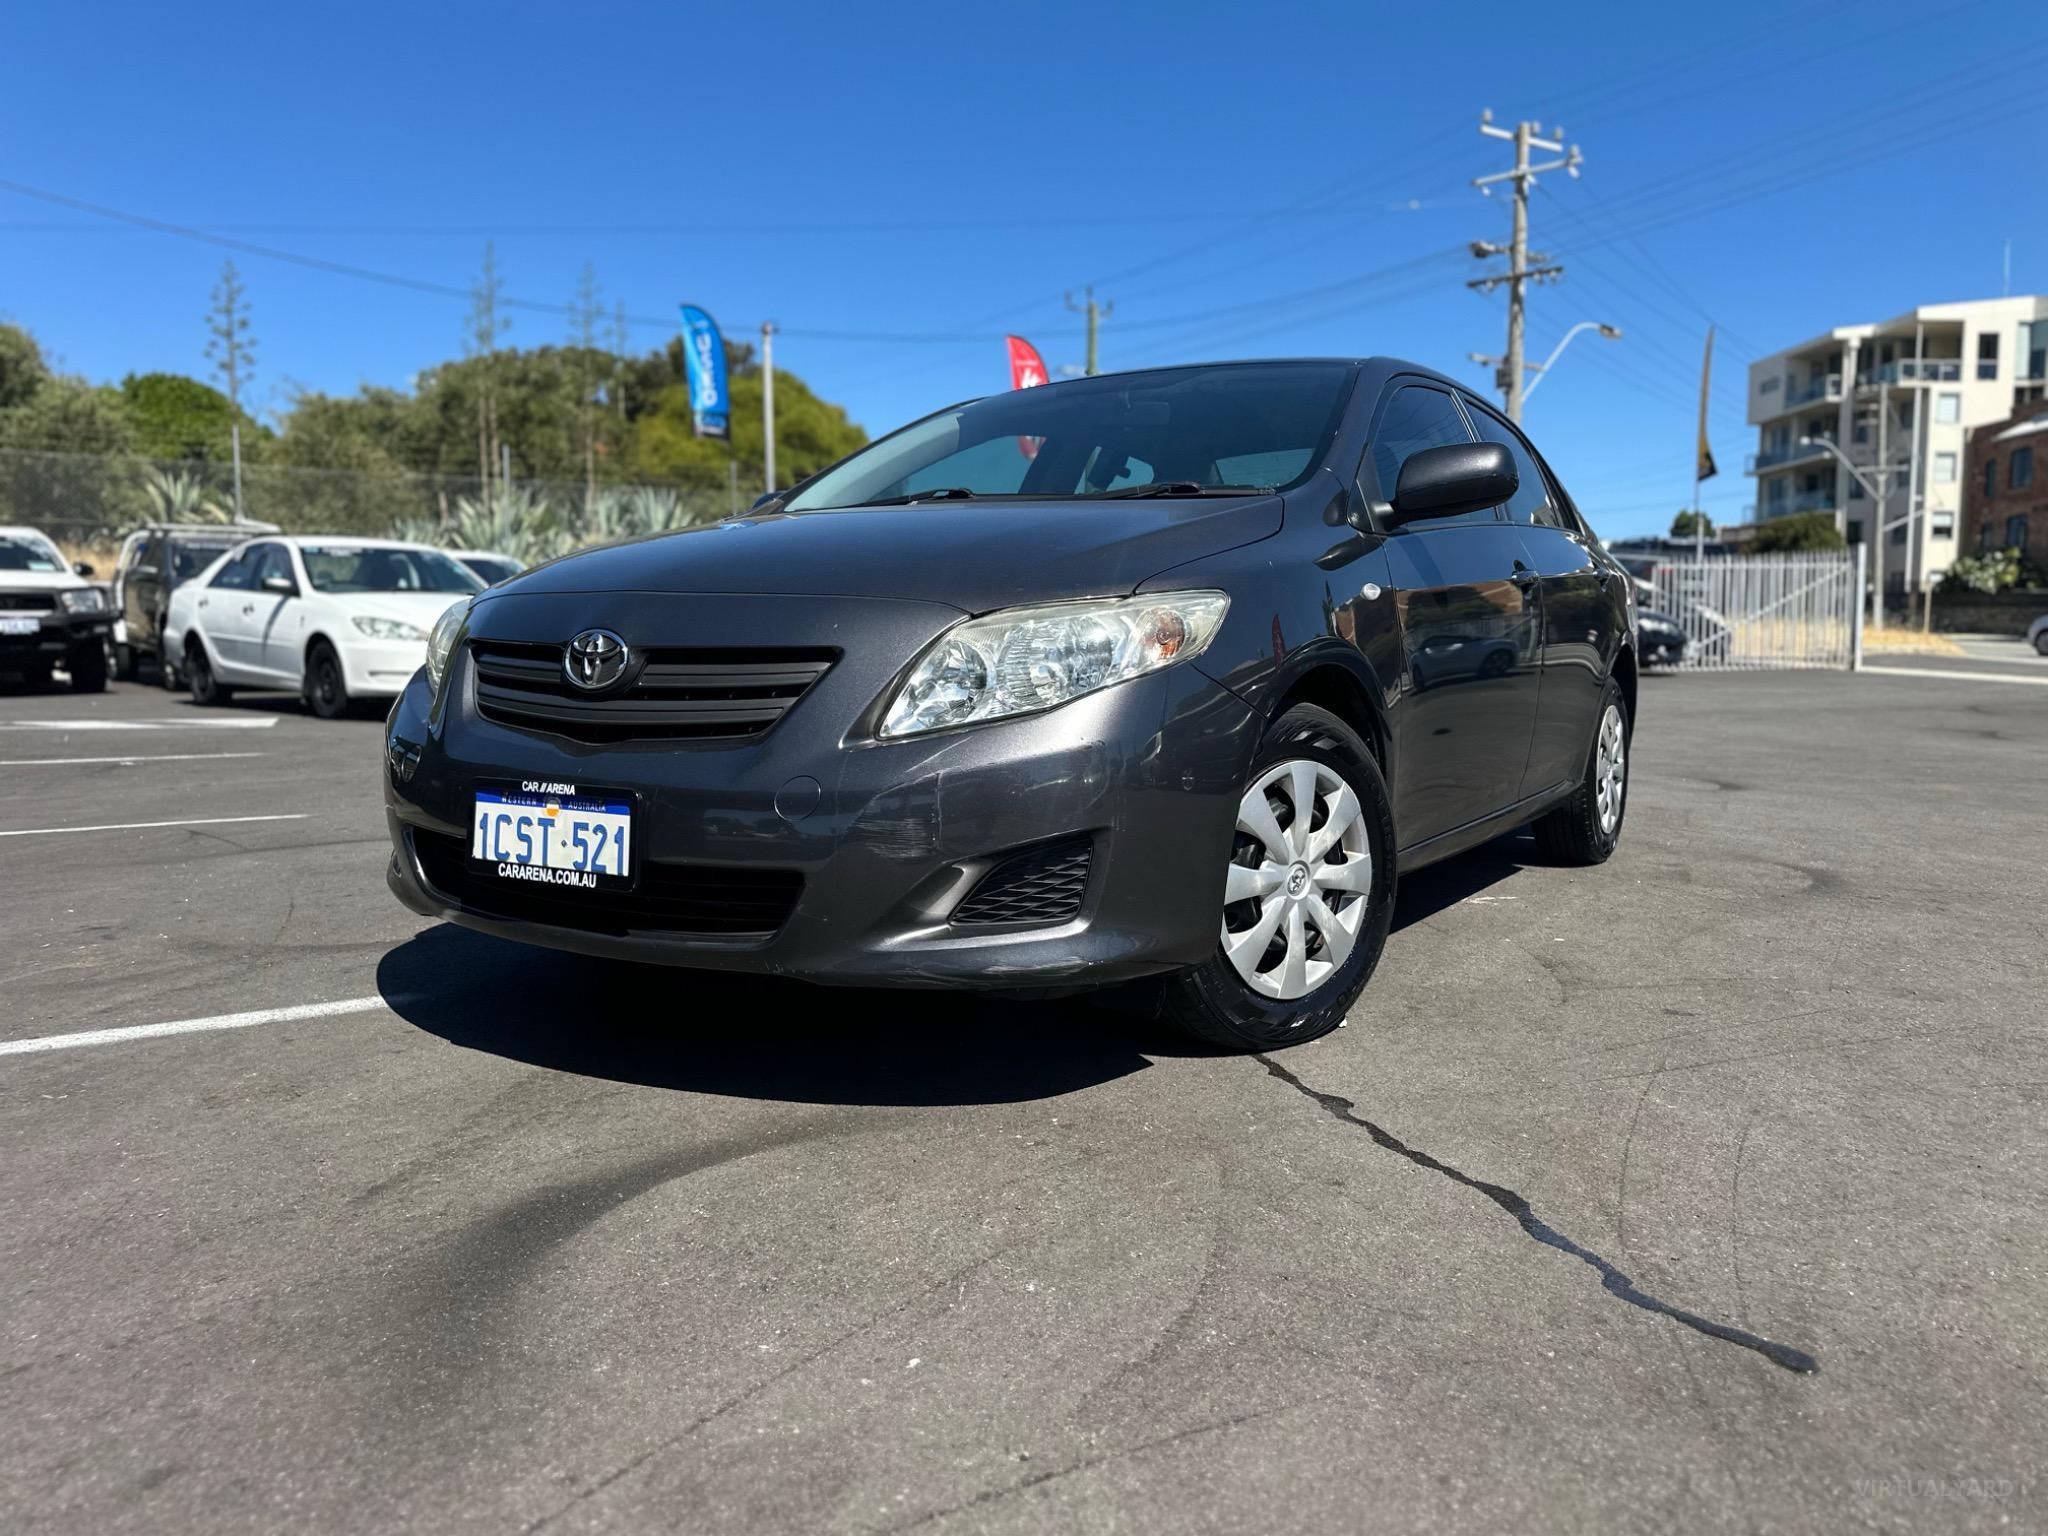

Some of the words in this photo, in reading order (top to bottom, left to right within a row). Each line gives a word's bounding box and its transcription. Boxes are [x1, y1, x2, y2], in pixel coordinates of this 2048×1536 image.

[501, 796, 537, 806] WESTERN
[568, 800, 607, 812] AUSTRALIA
[572, 821, 625, 876] 521
[498, 862, 597, 888] CARARENA.COM.AU
